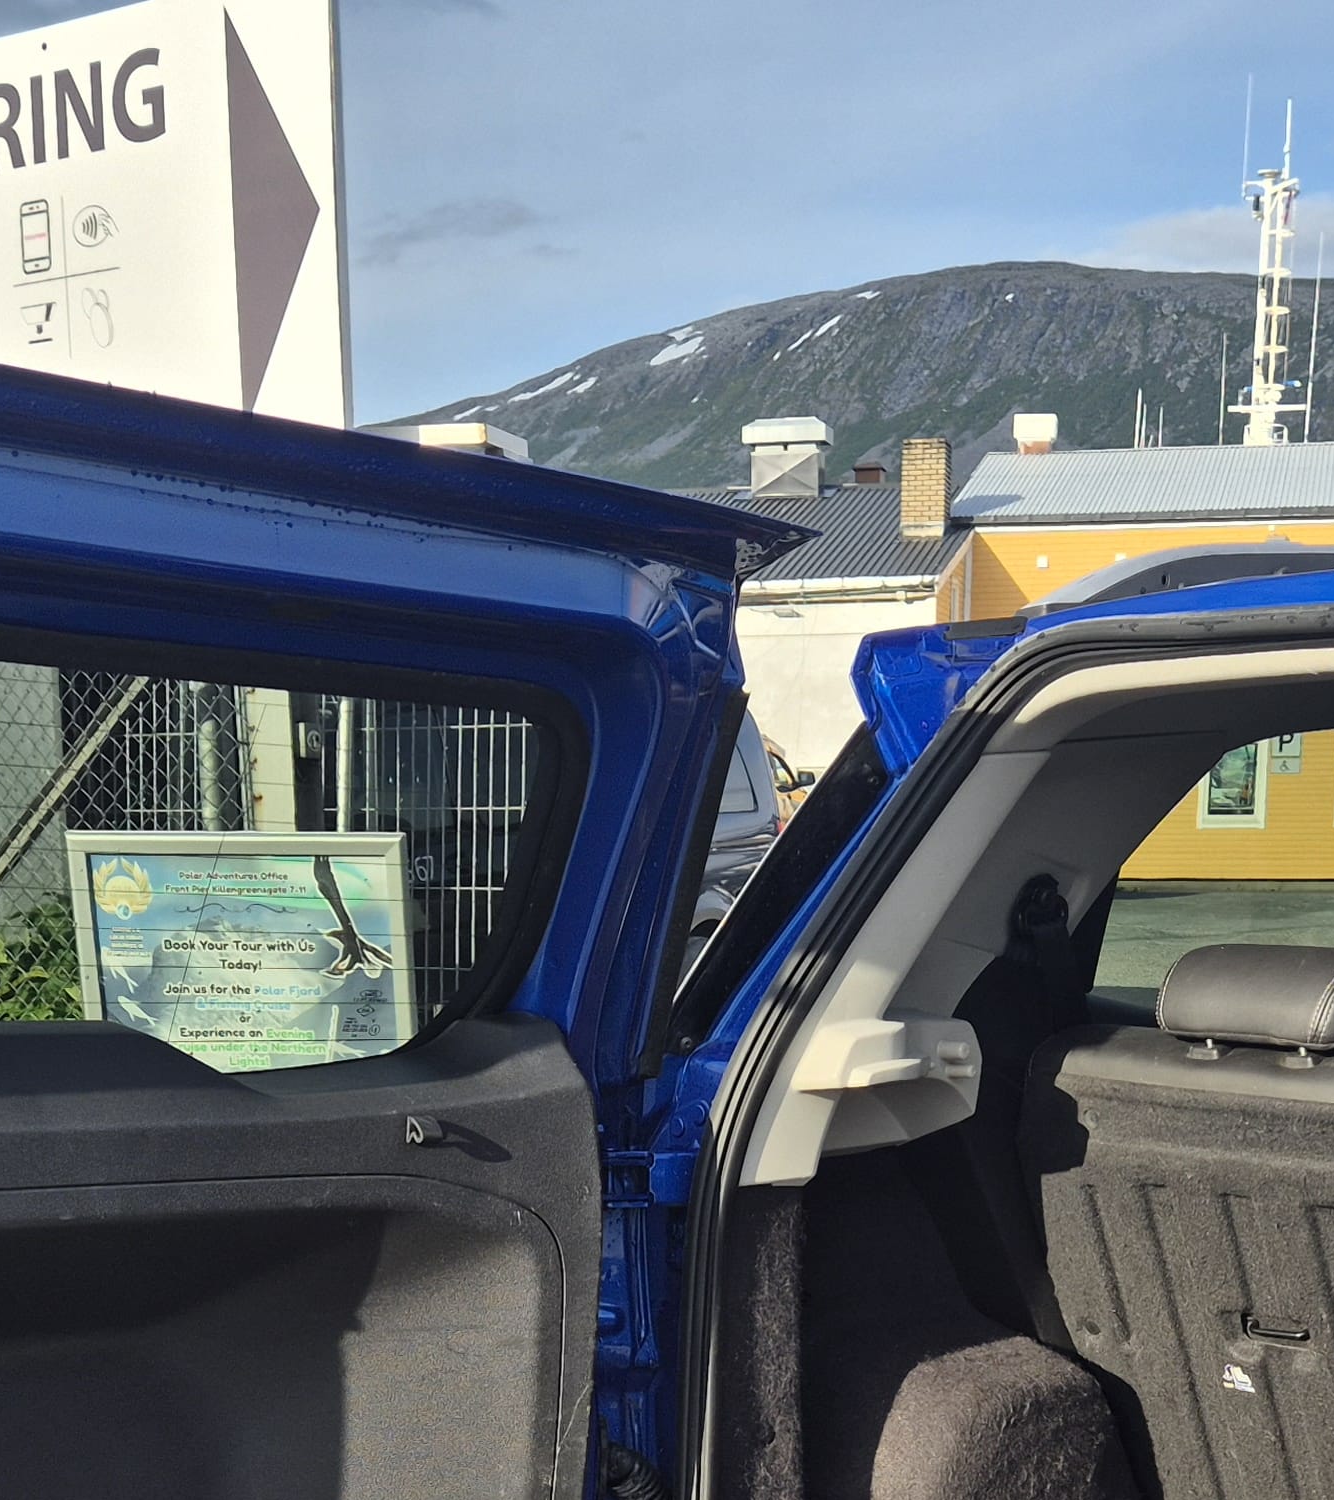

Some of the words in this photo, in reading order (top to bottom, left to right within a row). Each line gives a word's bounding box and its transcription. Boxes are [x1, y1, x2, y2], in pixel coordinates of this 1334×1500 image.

[1279, 733, 1294, 752] P
[179, 872, 203, 880] Polar
[206, 872, 258, 880] Adventures
[260, 872, 289, 880] Office
[165, 885, 189, 893] Front
[164, 939, 196, 950] Book
[199, 940, 229, 950] Your
[233, 940, 262, 951] Tour
[266, 940, 294, 951] with
[219, 959, 262, 972] Today!
[165, 984, 190, 994] Join
[193, 986, 207, 994] us
[210, 984, 228, 994] for
[231, 985, 251, 994] the
[254, 986, 285, 995] Polar
[289, 986, 321, 997] Fjord
[210, 999, 251, 1011] Fishing
[254, 1000, 291, 1010] Cruise
[239, 1015, 251, 1023] or
[180, 1028, 245, 1039] Experience
[249, 1029, 263, 1037] an
[267, 1028, 314, 1040] Evening
[177, 1043, 208, 1052] ruise
[211, 1043, 245, 1051] under
[250, 1043, 267, 1052] the
[272, 1043, 326, 1053] Northern
[230, 1056, 269, 1068] Lights!
